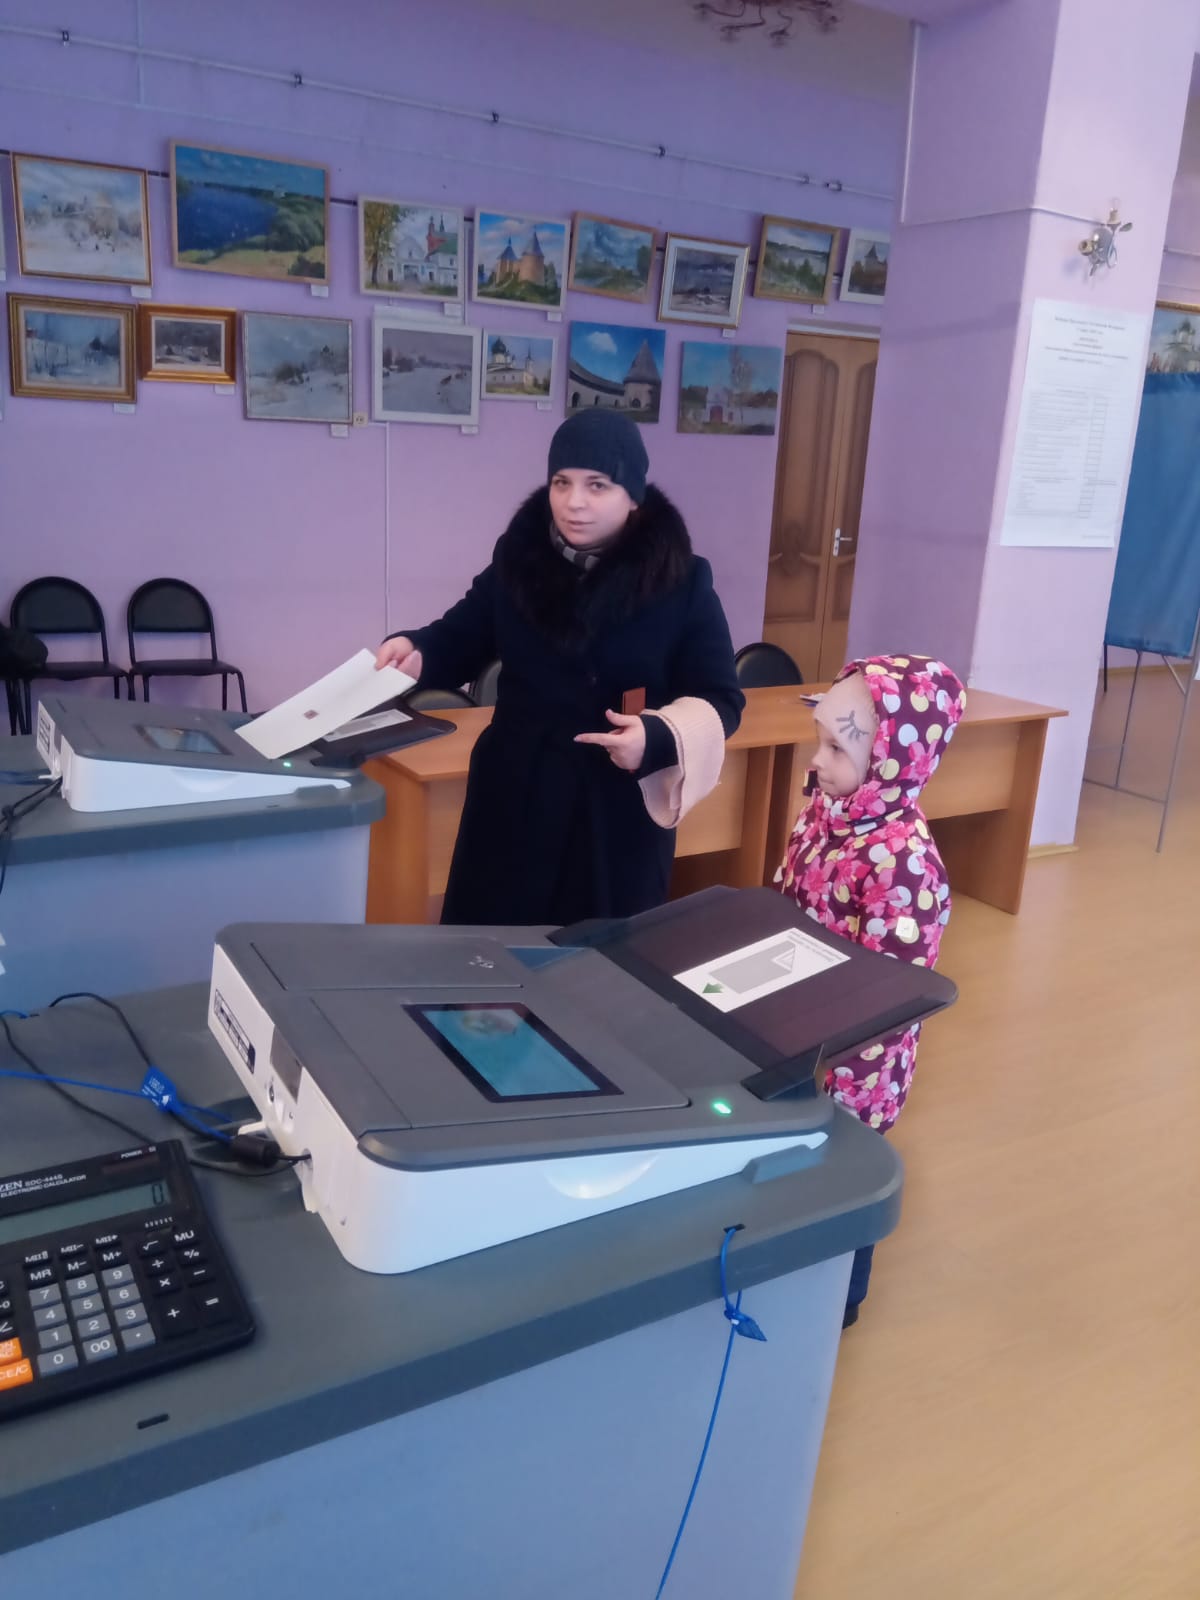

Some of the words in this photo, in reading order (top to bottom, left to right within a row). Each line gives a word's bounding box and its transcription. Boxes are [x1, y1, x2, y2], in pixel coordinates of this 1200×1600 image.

[44, 1174, 87, 1188] CALCULATOR
[152, 1183, 163, 1204] 0
[174, 1230, 194, 1242] MU
[30, 1268, 52, 1281] MR
[112, 1270, 123, 1280] 9
[77, 1280, 88, 1289] 8
[40, 1289, 50, 1299] 7
[119, 1289, 130, 1299] 6
[83, 1300, 94, 1310] 5
[45, 1309, 56, 1319] 4
[125, 1309, 137, 1320] 3
[89, 1319, 100, 1331] 2
[51, 1331, 60, 1341] 1
[90, 1339, 111, 1353] 00
[53, 1353, 64, 1365] 0
